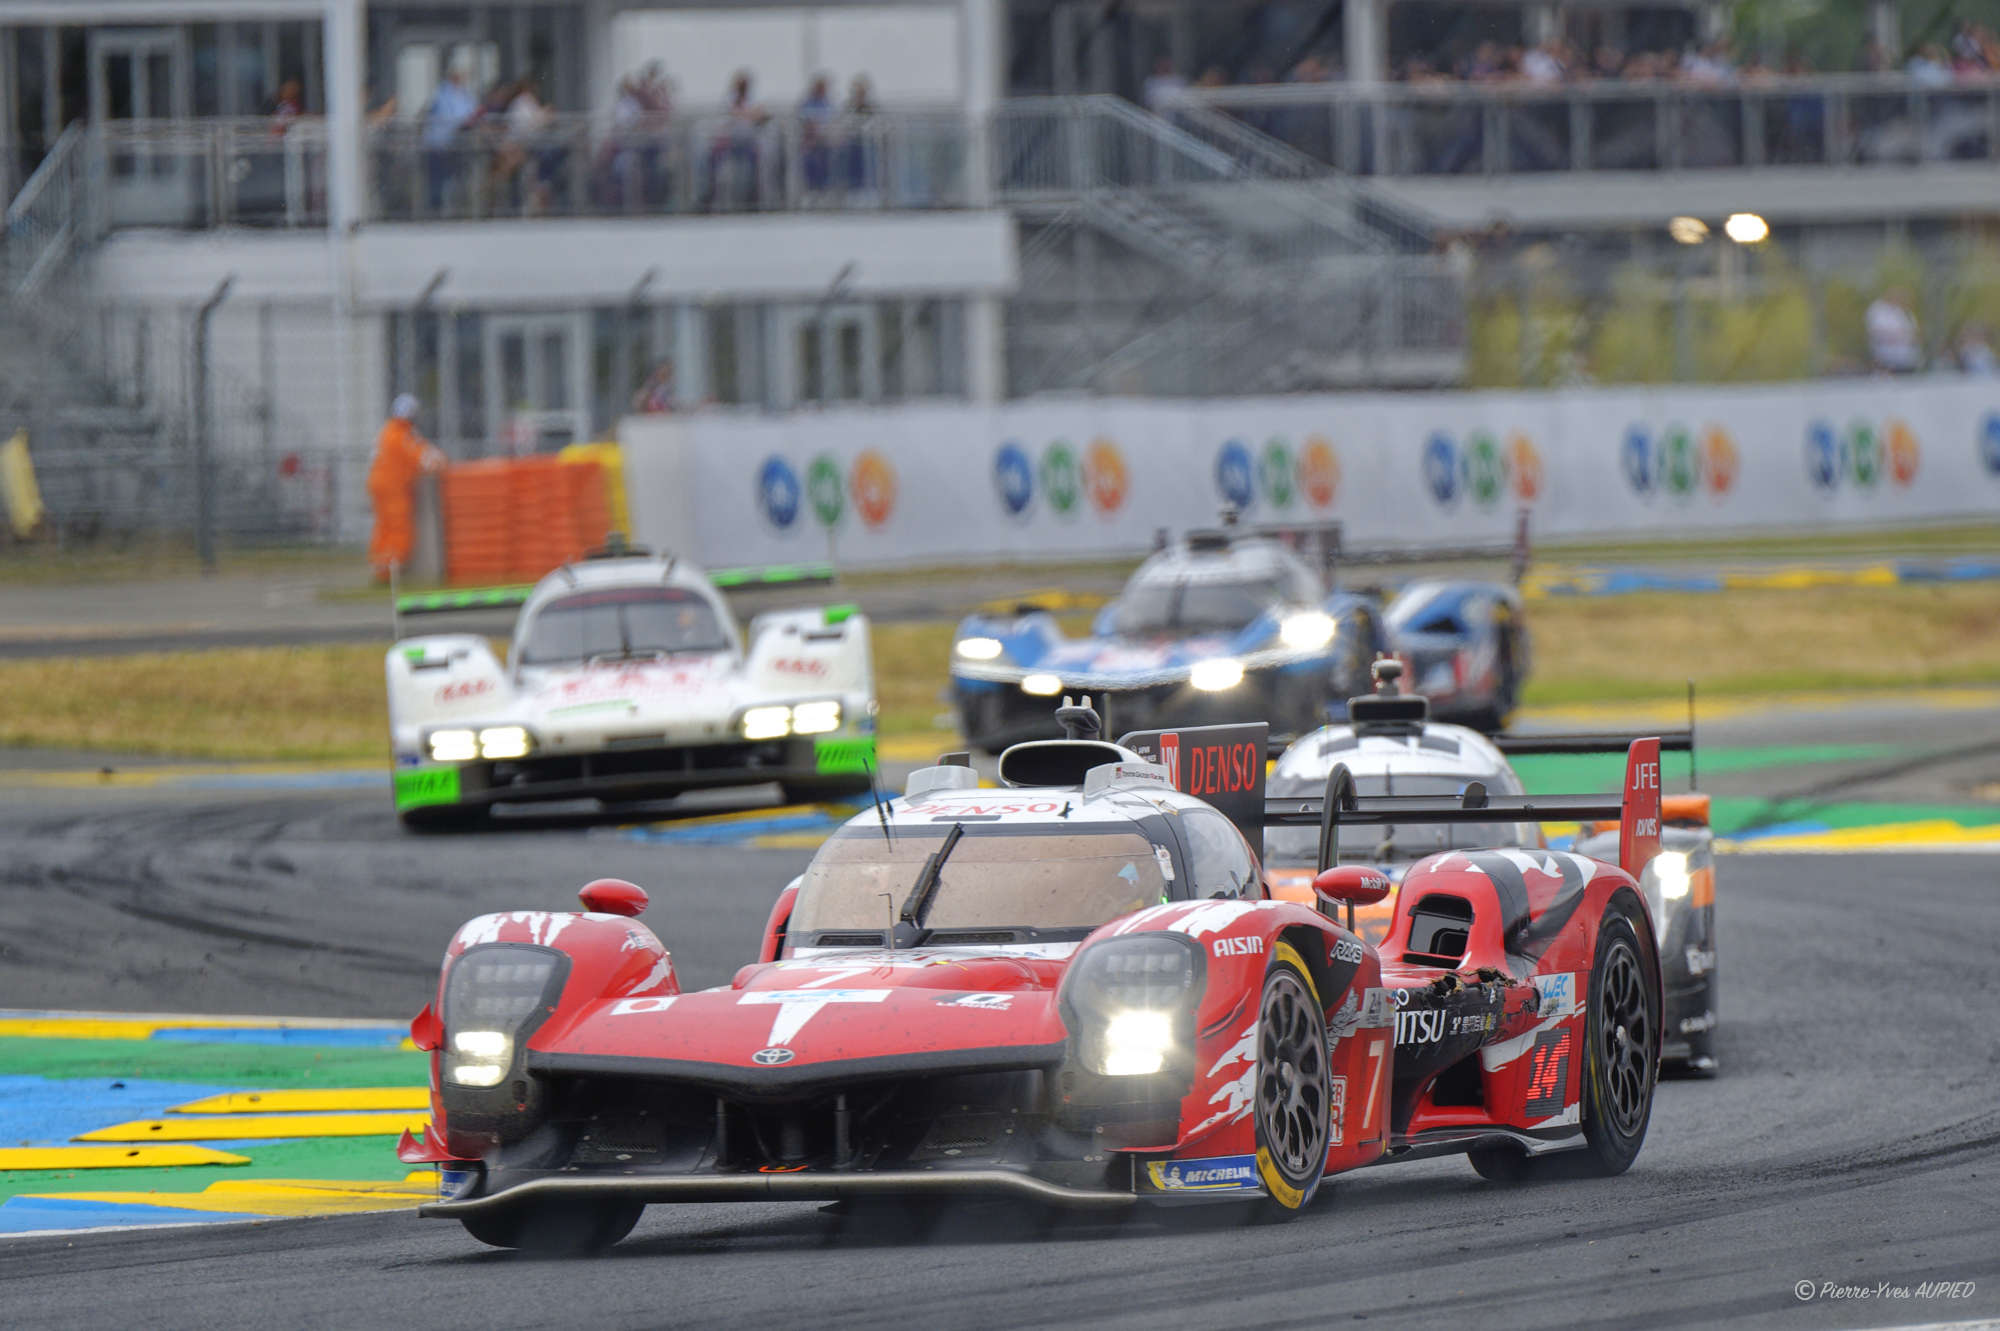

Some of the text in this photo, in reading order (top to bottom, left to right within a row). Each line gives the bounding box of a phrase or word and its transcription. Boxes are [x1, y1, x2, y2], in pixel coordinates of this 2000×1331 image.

[1190, 742, 1257, 796] DENSO
[1631, 762, 1659, 790] JFE
[900, 801, 1059, 816] DENSO
[1213, 935, 1264, 958] AISIN
[799, 967, 873, 989] 7
[1543, 974, 1569, 999] WEC
[1363, 1039, 1386, 1129] 7
[1185, 1166, 1251, 1183] MICHELIN
